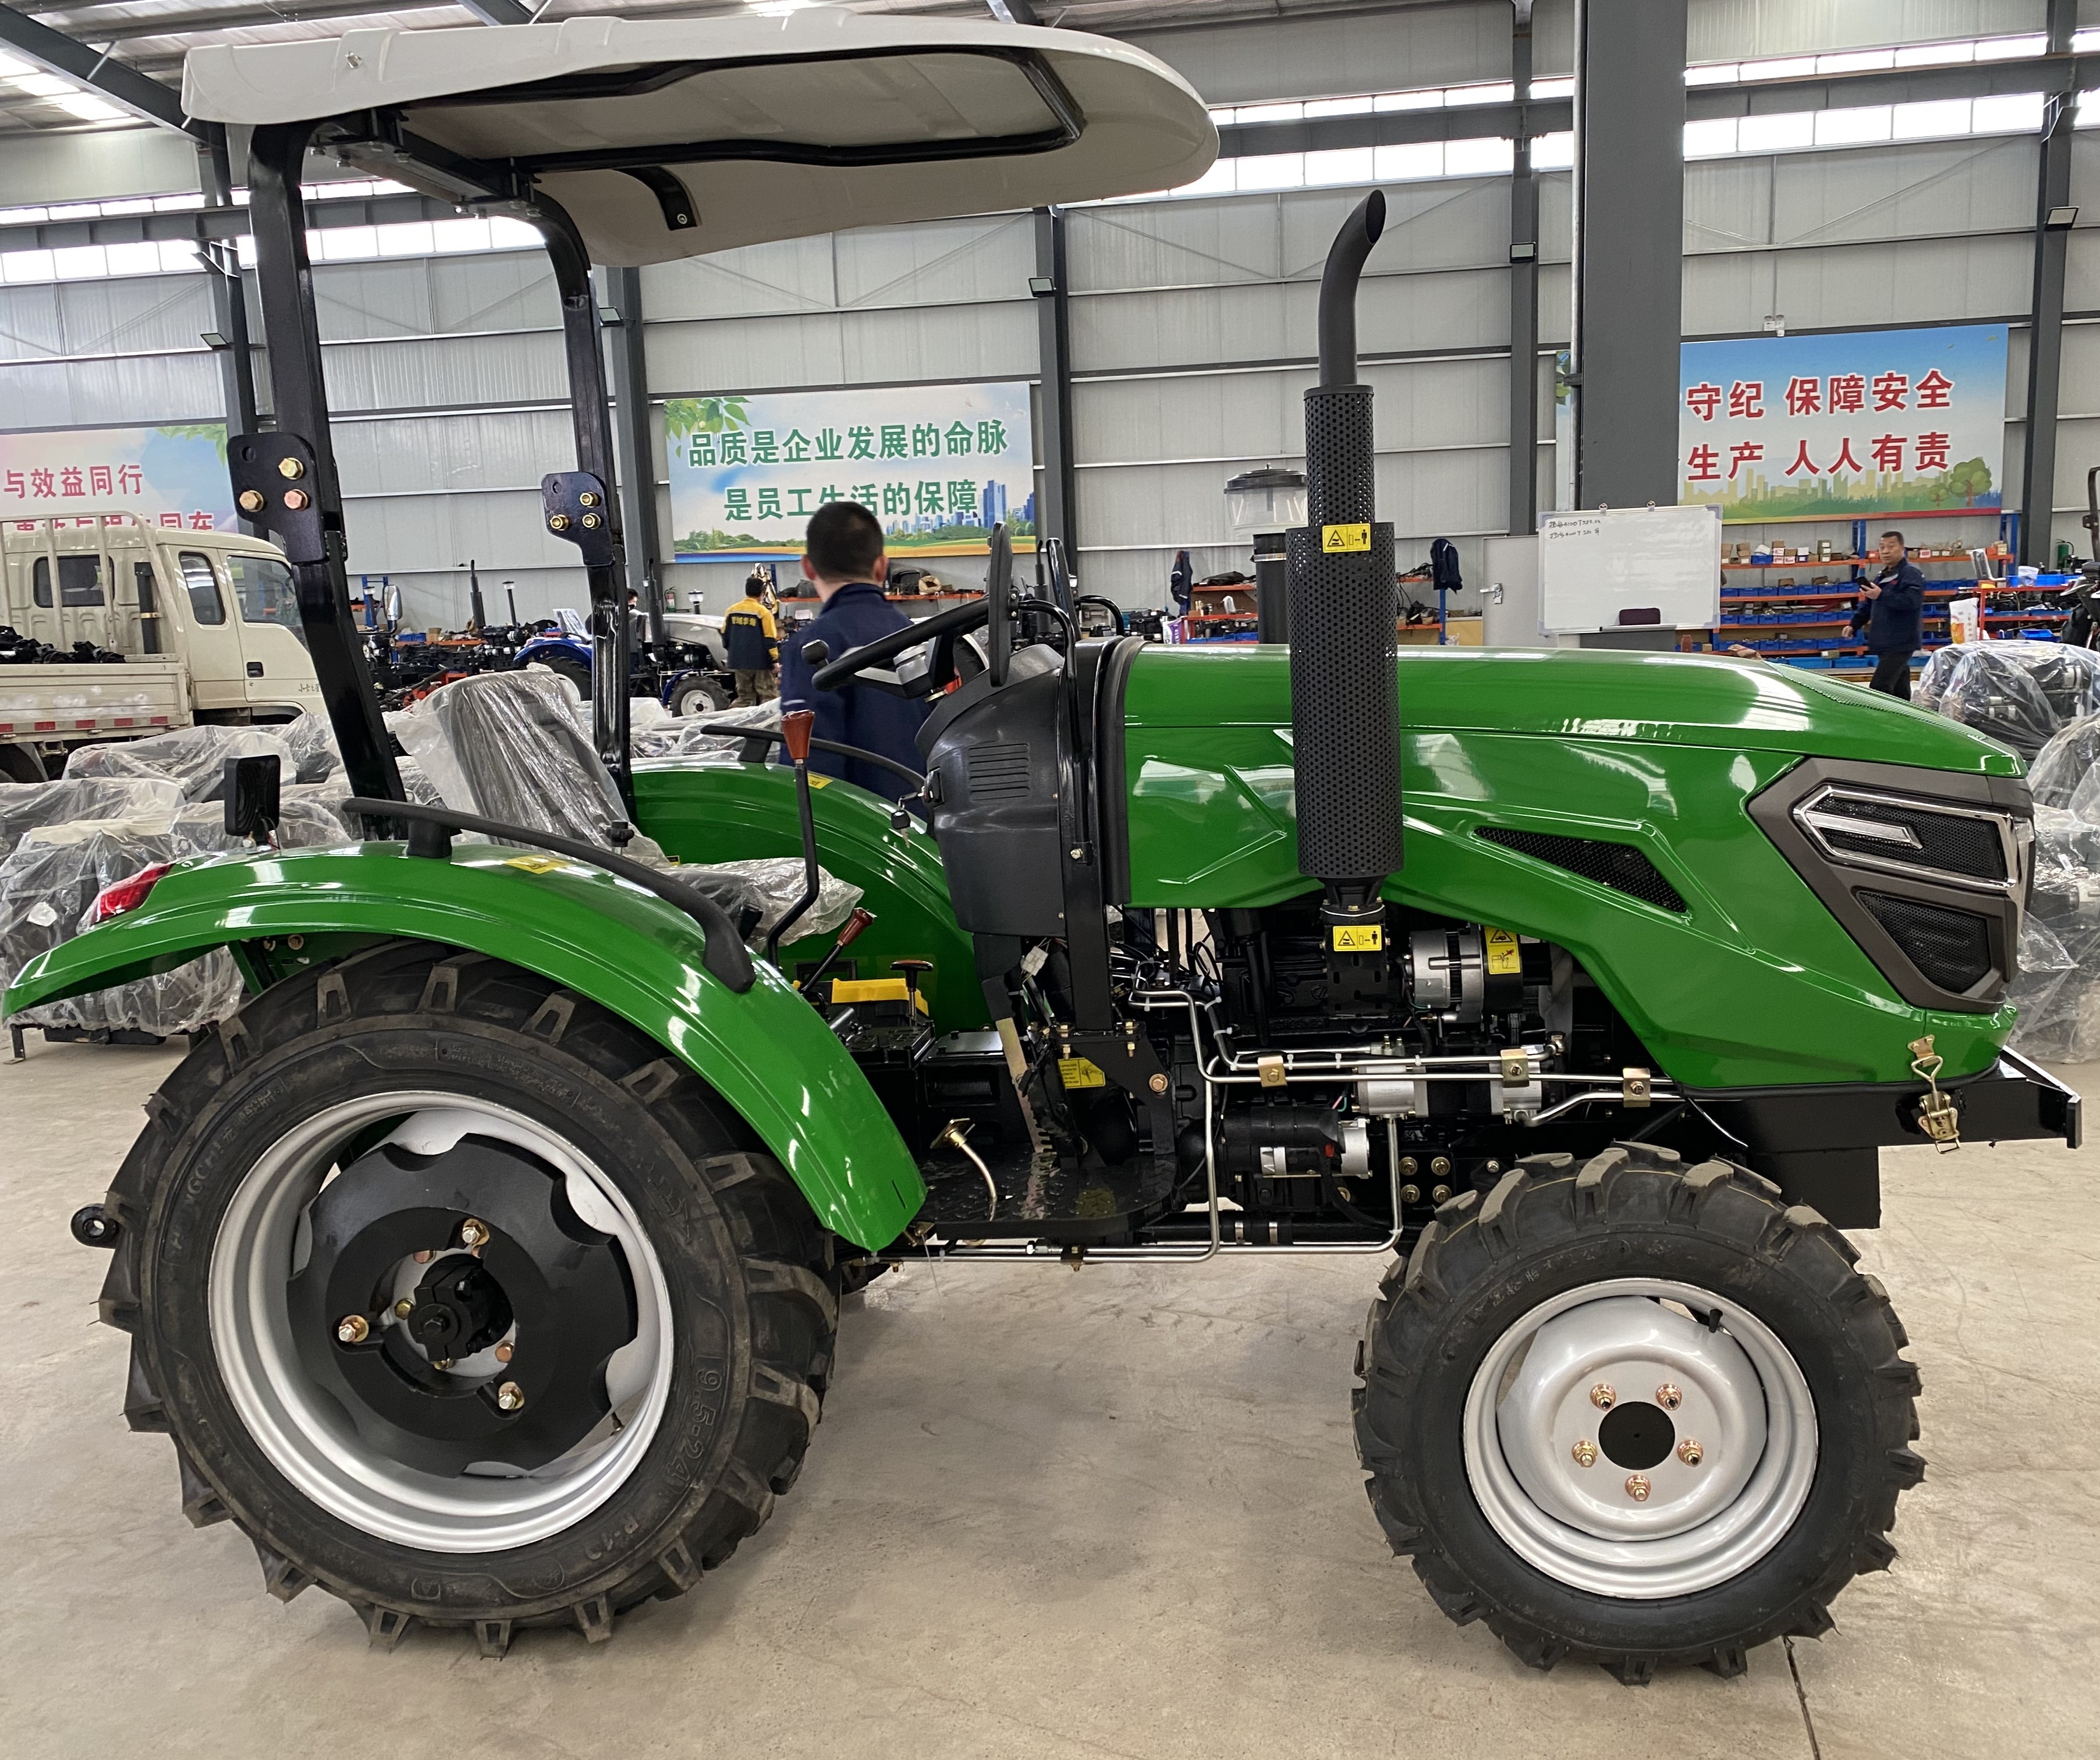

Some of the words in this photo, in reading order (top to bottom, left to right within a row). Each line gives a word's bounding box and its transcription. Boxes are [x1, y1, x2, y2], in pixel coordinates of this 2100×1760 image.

[1687, 382, 1764, 421] 守纪
[1785, 370, 1954, 416] 保障安全
[689, 419, 1008, 466] 品质是企业发展的命脉
[1688, 441, 1764, 481] 生产
[1785, 431, 1951, 476] 人人有责
[3, 464, 143, 499] 与效益同行
[723, 479, 978, 521] 是员工生活的保障
[665, 1368, 722, 1485] 9.5-24
